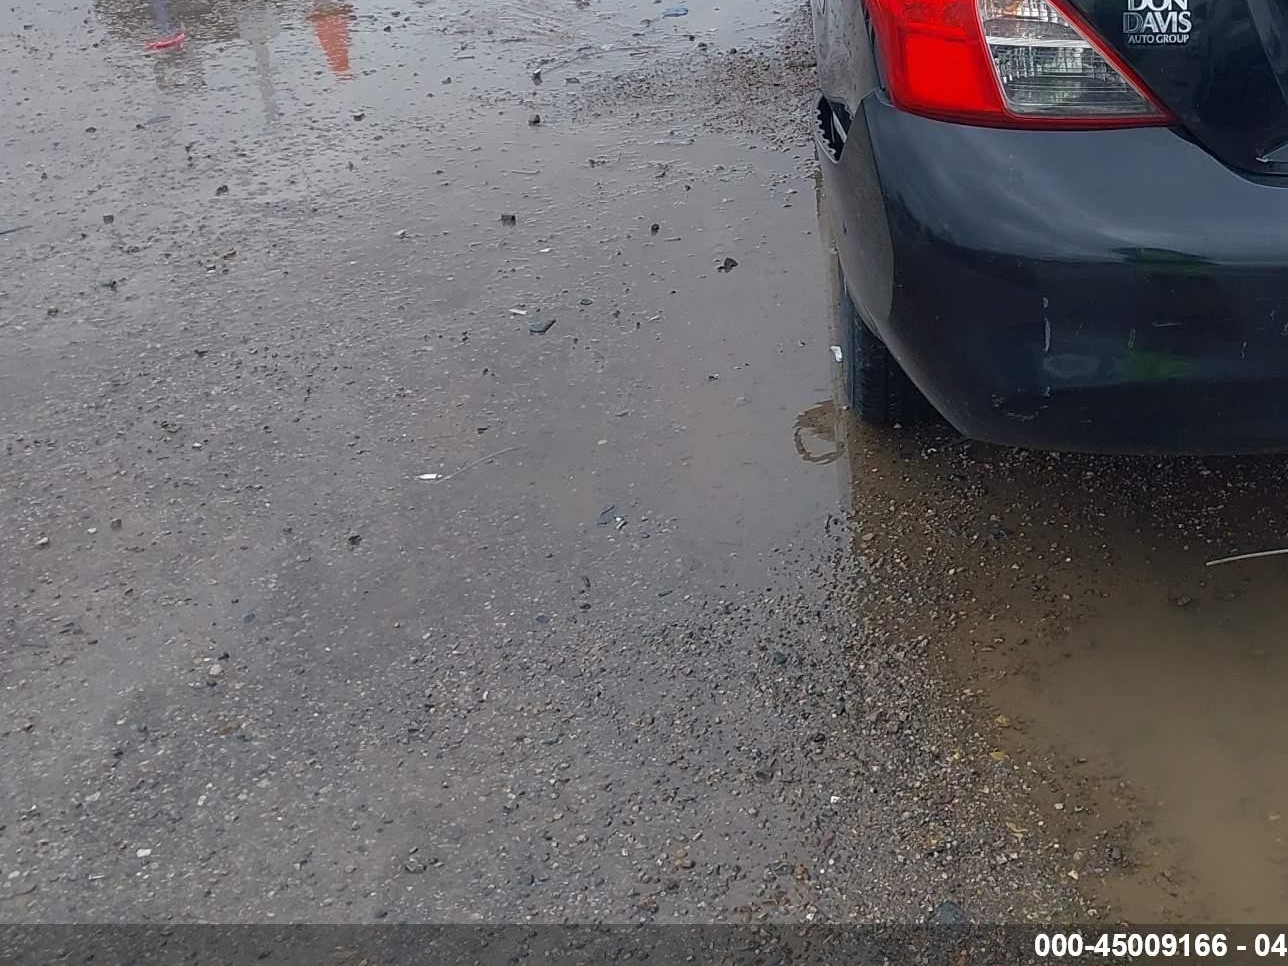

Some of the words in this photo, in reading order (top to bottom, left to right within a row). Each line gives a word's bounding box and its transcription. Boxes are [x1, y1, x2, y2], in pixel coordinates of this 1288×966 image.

[1122, 11, 1192, 34] DAVIS
[1128, 34, 1155, 44] AUTO
[1156, 34, 1190, 44] GROUP
